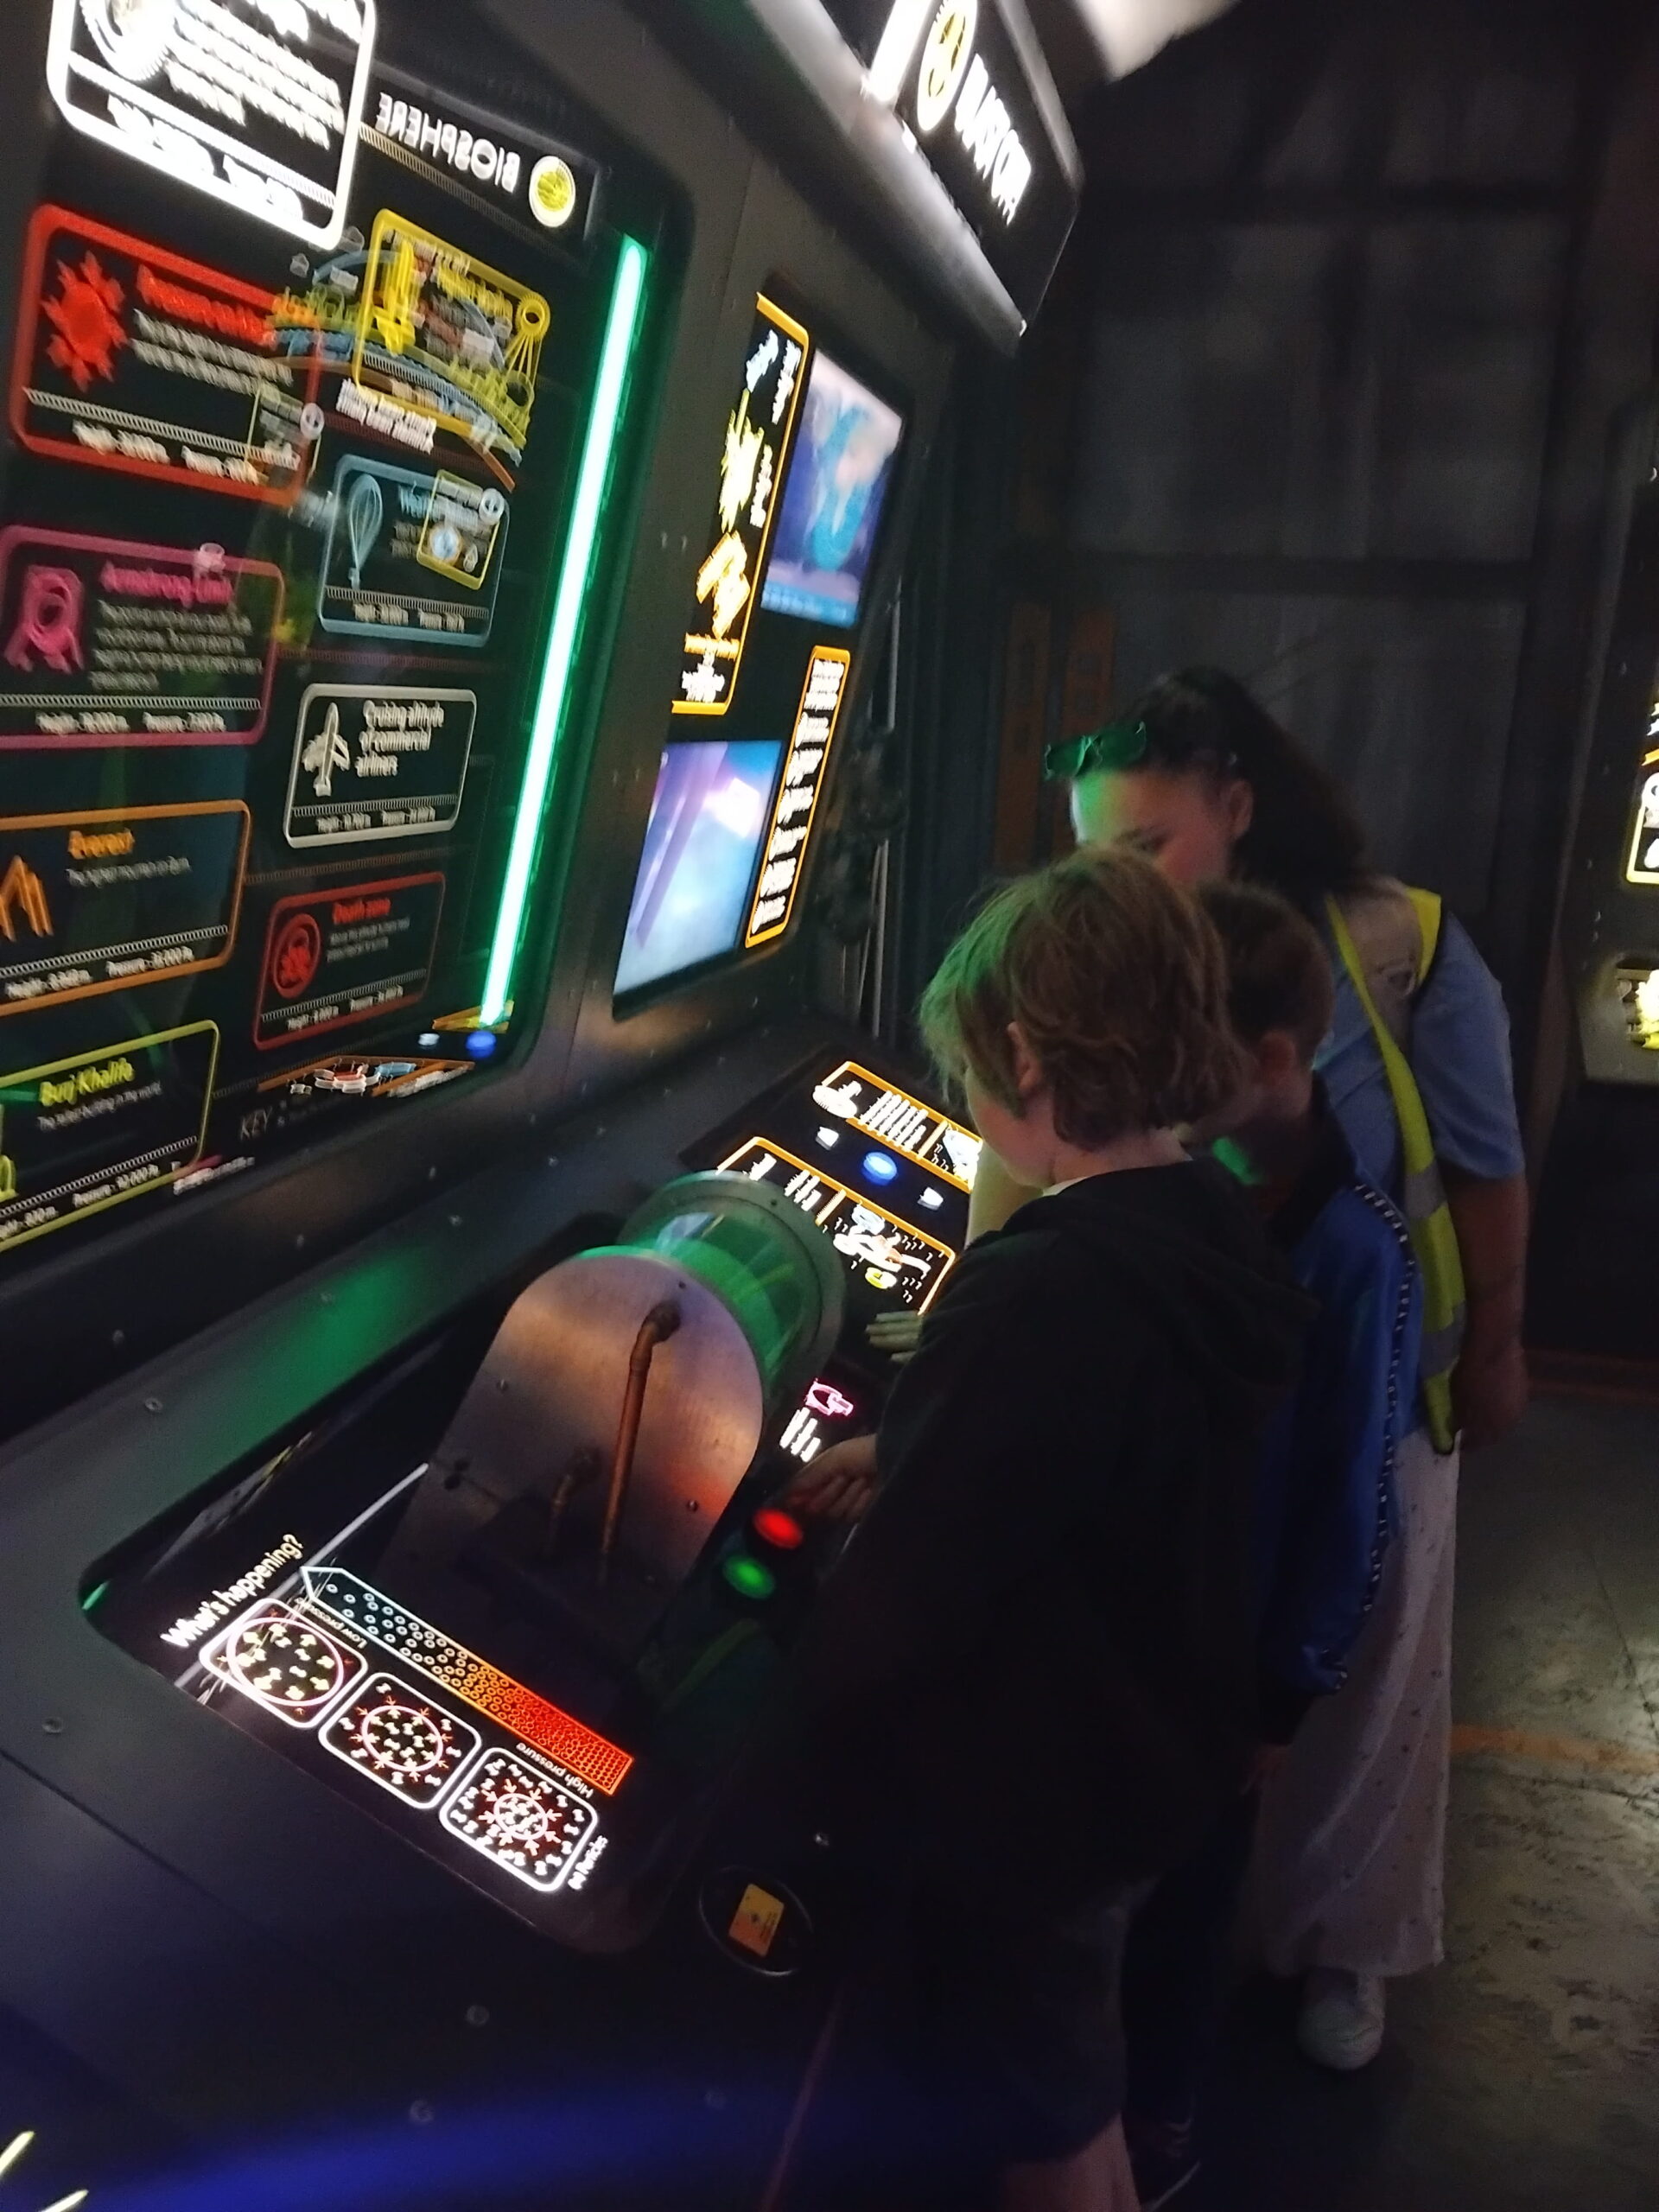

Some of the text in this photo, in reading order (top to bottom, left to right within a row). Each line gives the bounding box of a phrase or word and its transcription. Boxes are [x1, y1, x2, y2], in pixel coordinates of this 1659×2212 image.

[160, 1534, 304, 1648] What's happening?
[295, 1597, 367, 1649] Low pressure
[516, 1742, 594, 1799] High pressure
